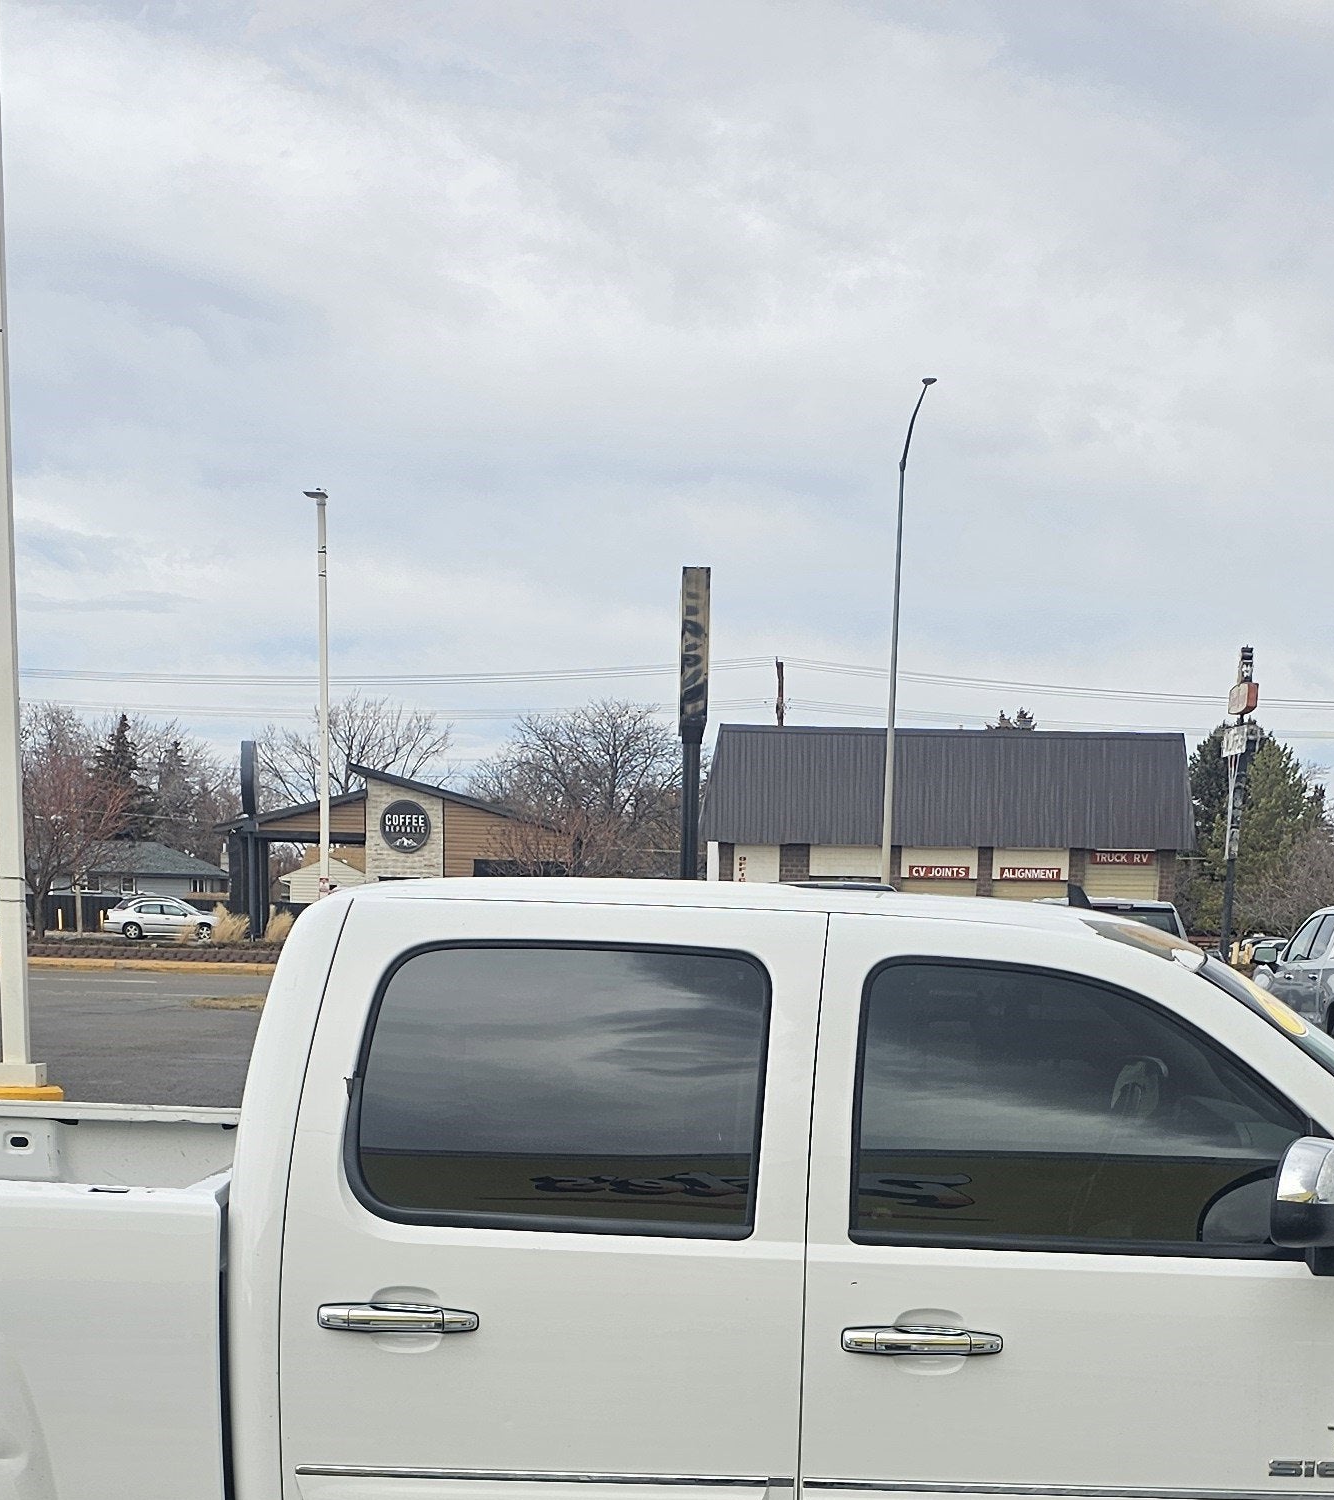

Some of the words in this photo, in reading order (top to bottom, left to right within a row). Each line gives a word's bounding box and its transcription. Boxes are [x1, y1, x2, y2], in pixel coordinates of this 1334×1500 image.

[385, 814, 425, 826] COFFEE
[385, 825, 426, 833] REPUBLIC
[1096, 853, 1128, 863] TRUCK
[1133, 853, 1149, 863] RV
[912, 866, 926, 876] CV
[929, 867, 966, 877] JOINTS
[1002, 868, 1059, 879] ALIGNMENT
